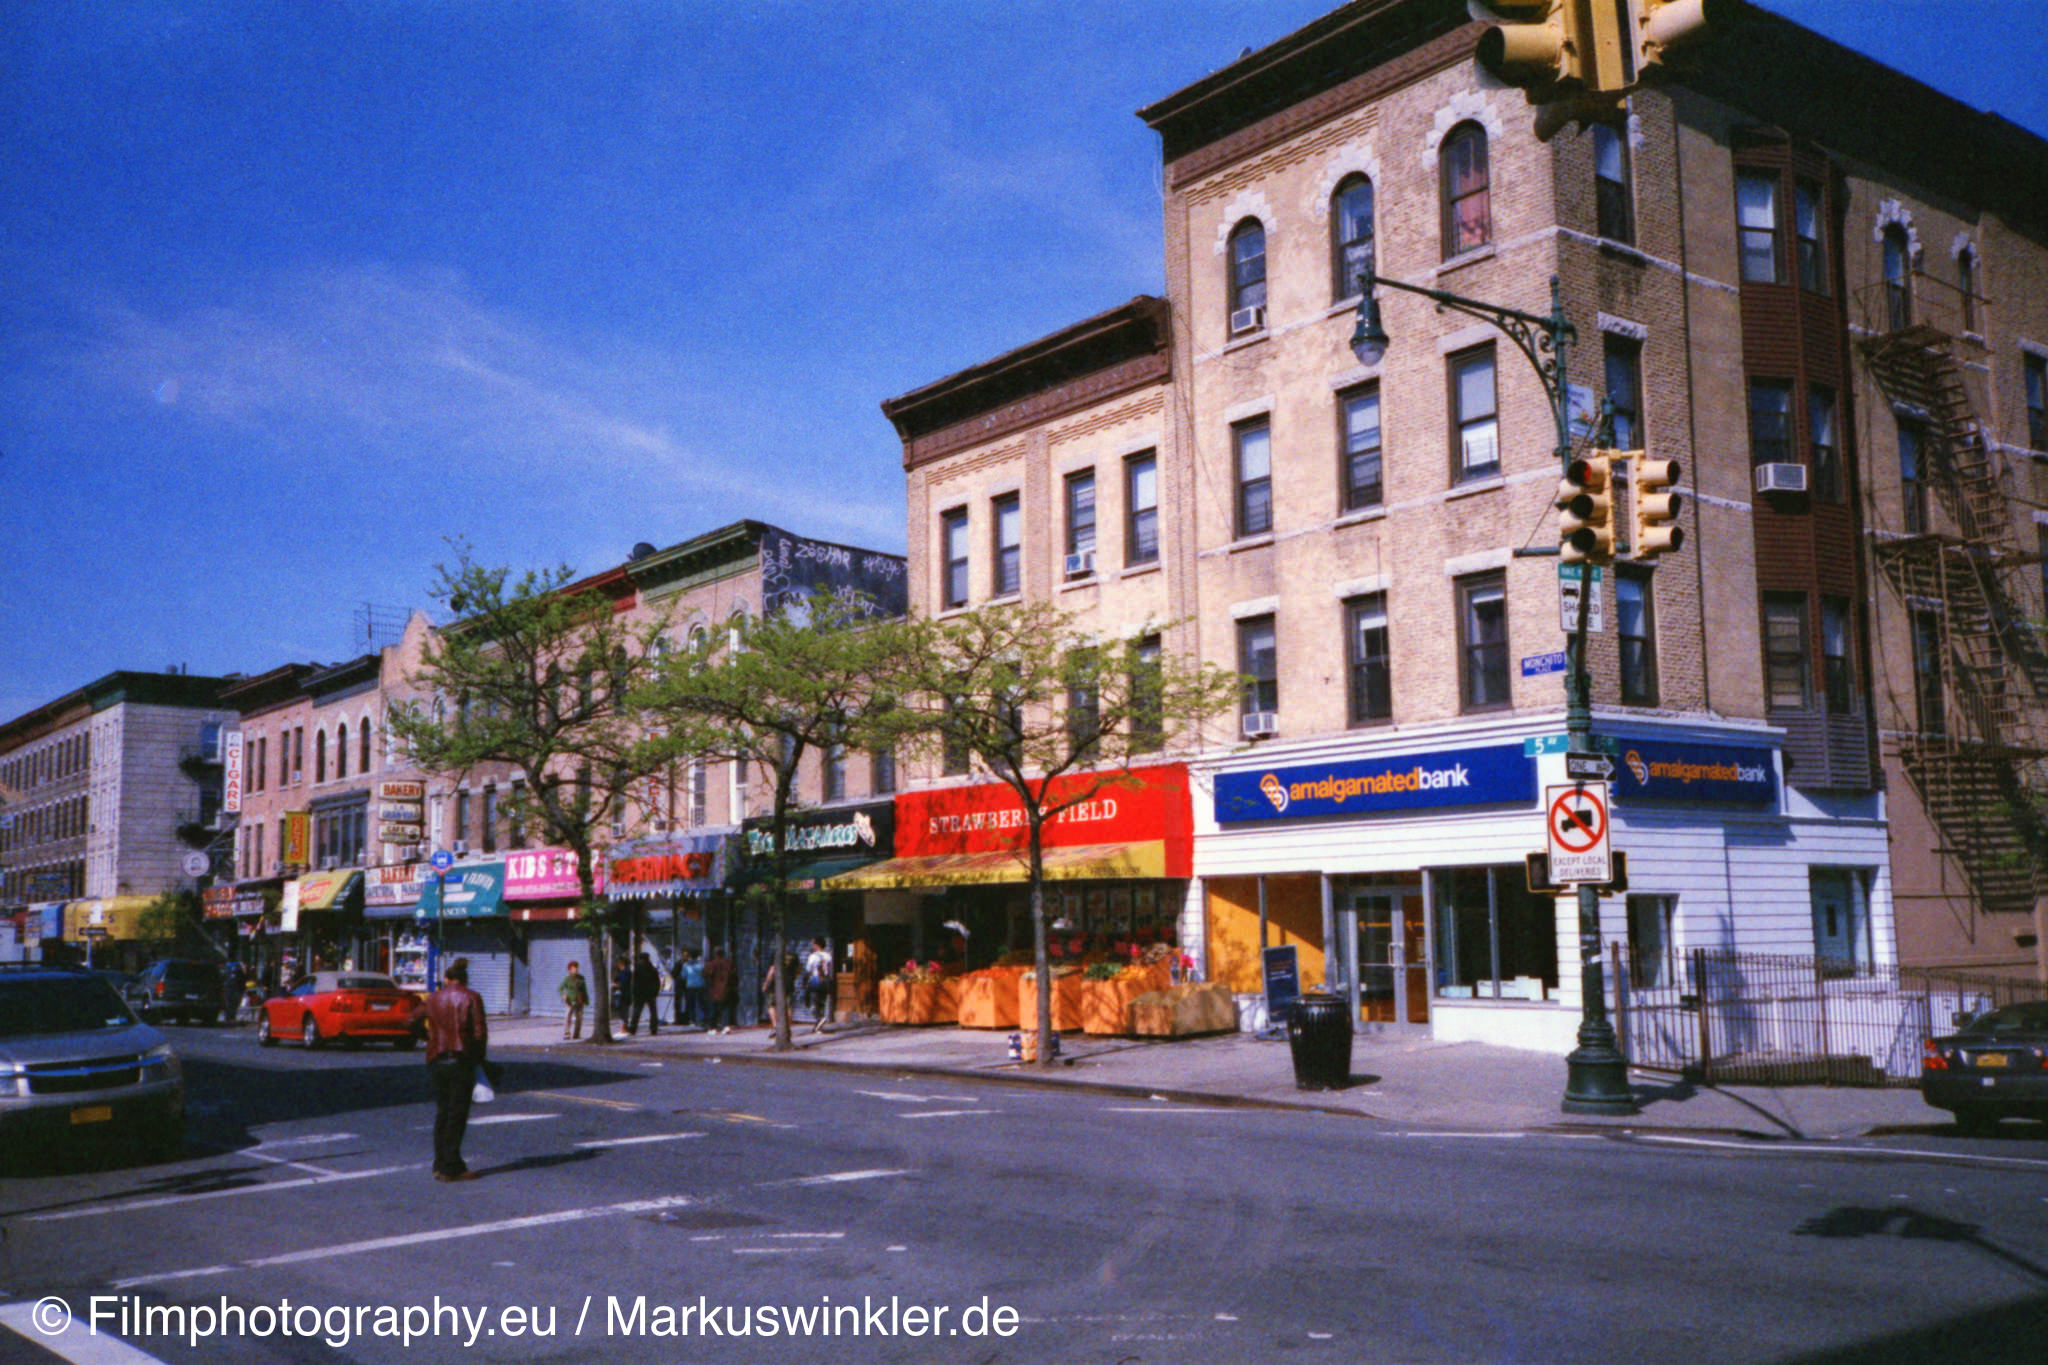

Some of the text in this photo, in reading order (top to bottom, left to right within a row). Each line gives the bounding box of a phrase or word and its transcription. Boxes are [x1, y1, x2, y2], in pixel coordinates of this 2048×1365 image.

[1534, 737, 1544, 754] 5
[1569, 759, 1587, 772] ONE
[1650, 758, 1767, 784] amalgamatedbank
[226, 749, 240, 810] CIGARS
[383, 784, 420, 796] BAKERY
[1290, 763, 1469, 802] amalgamatedbank
[1056, 799, 1118, 823] FIELD
[508, 854, 547, 879] KIDS
[611, 852, 714, 883] PHARMACY
[1553, 855, 1607, 867] EXCEPT LOCAL
[380, 865, 416, 884] BAKERY
[1560, 867, 1602, 877] DELIVERIES
